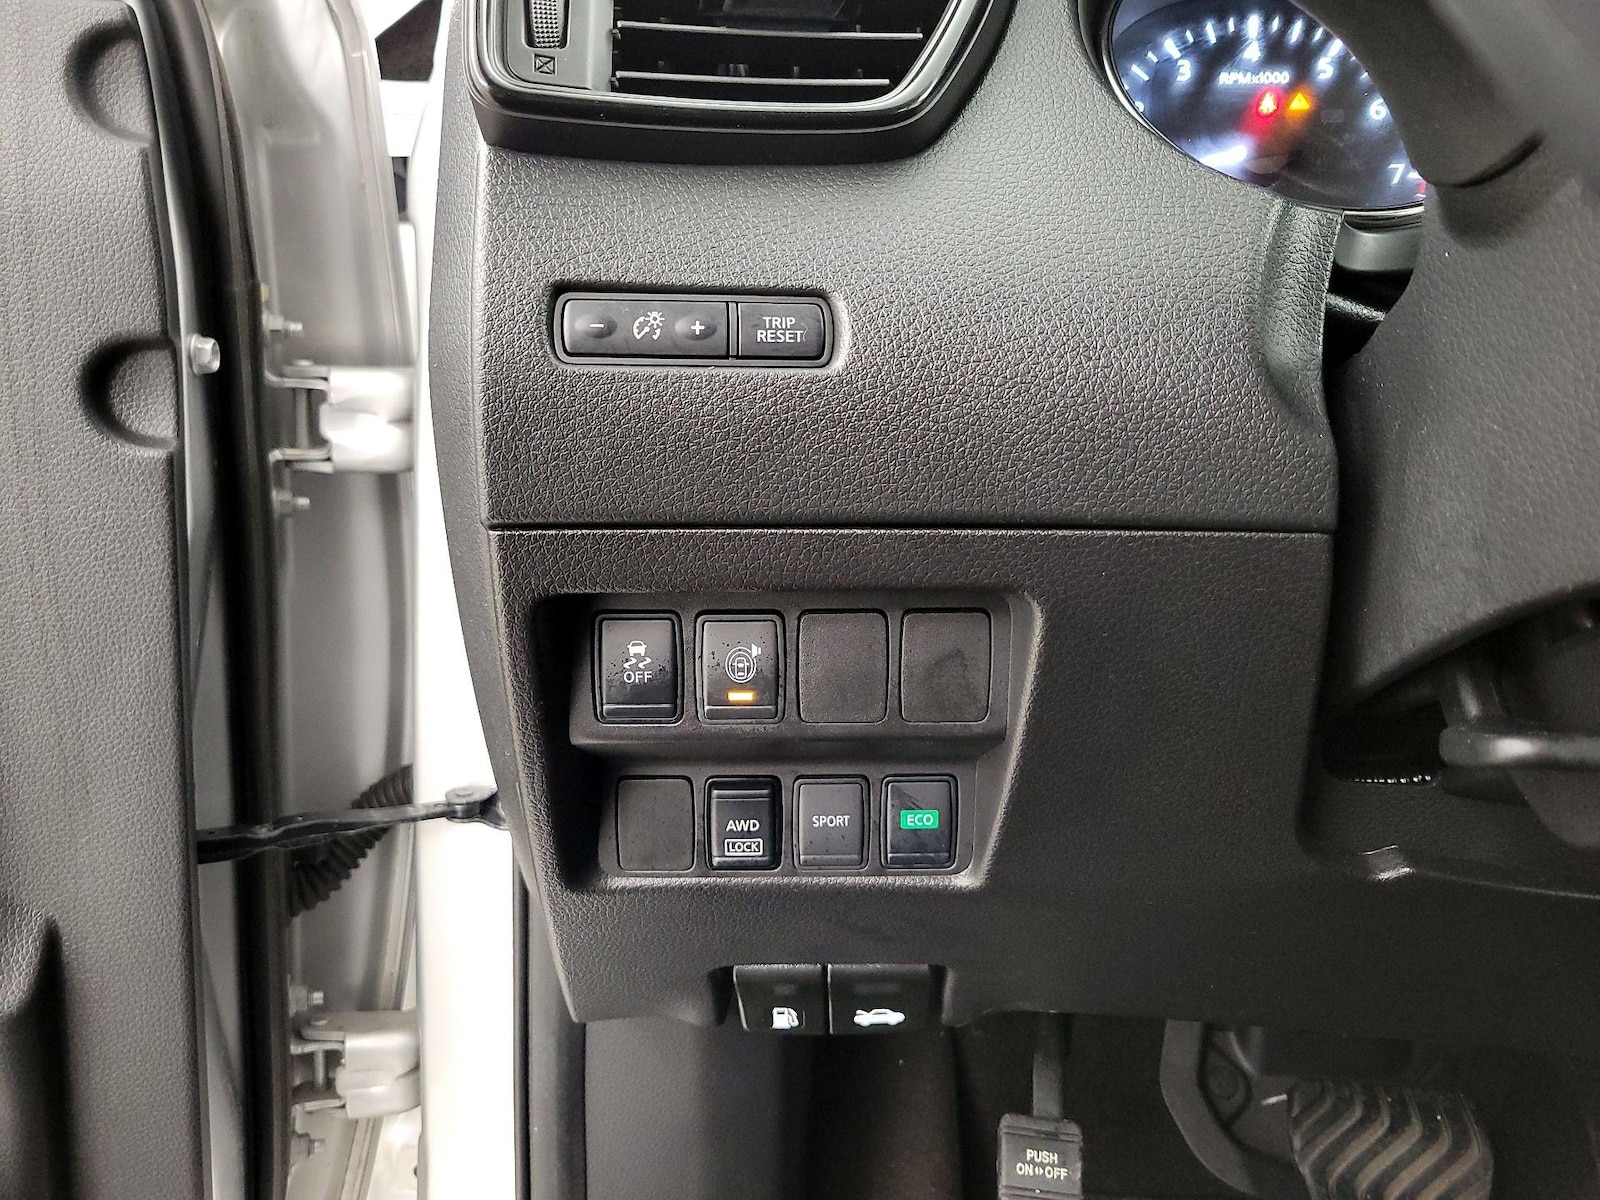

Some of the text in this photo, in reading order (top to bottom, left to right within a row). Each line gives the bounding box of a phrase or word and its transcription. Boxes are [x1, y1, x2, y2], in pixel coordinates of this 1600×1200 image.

[1175, 60, 1192, 82] 3
[1317, 57, 1335, 79] 5
[1369, 98, 1387, 121] 6
[1387, 163, 1405, 184] 7
[762, 316, 796, 329] TRIP
[756, 330, 804, 343] RESET
[623, 671, 653, 684] OFF
[725, 819, 760, 832] AWD
[812, 815, 850, 828] SPORT
[906, 813, 934, 827] ECO
[728, 841, 759, 853] LOCK
[1026, 1148, 1059, 1165] PUSH
[1016, 1162, 1069, 1180] ON OFF
